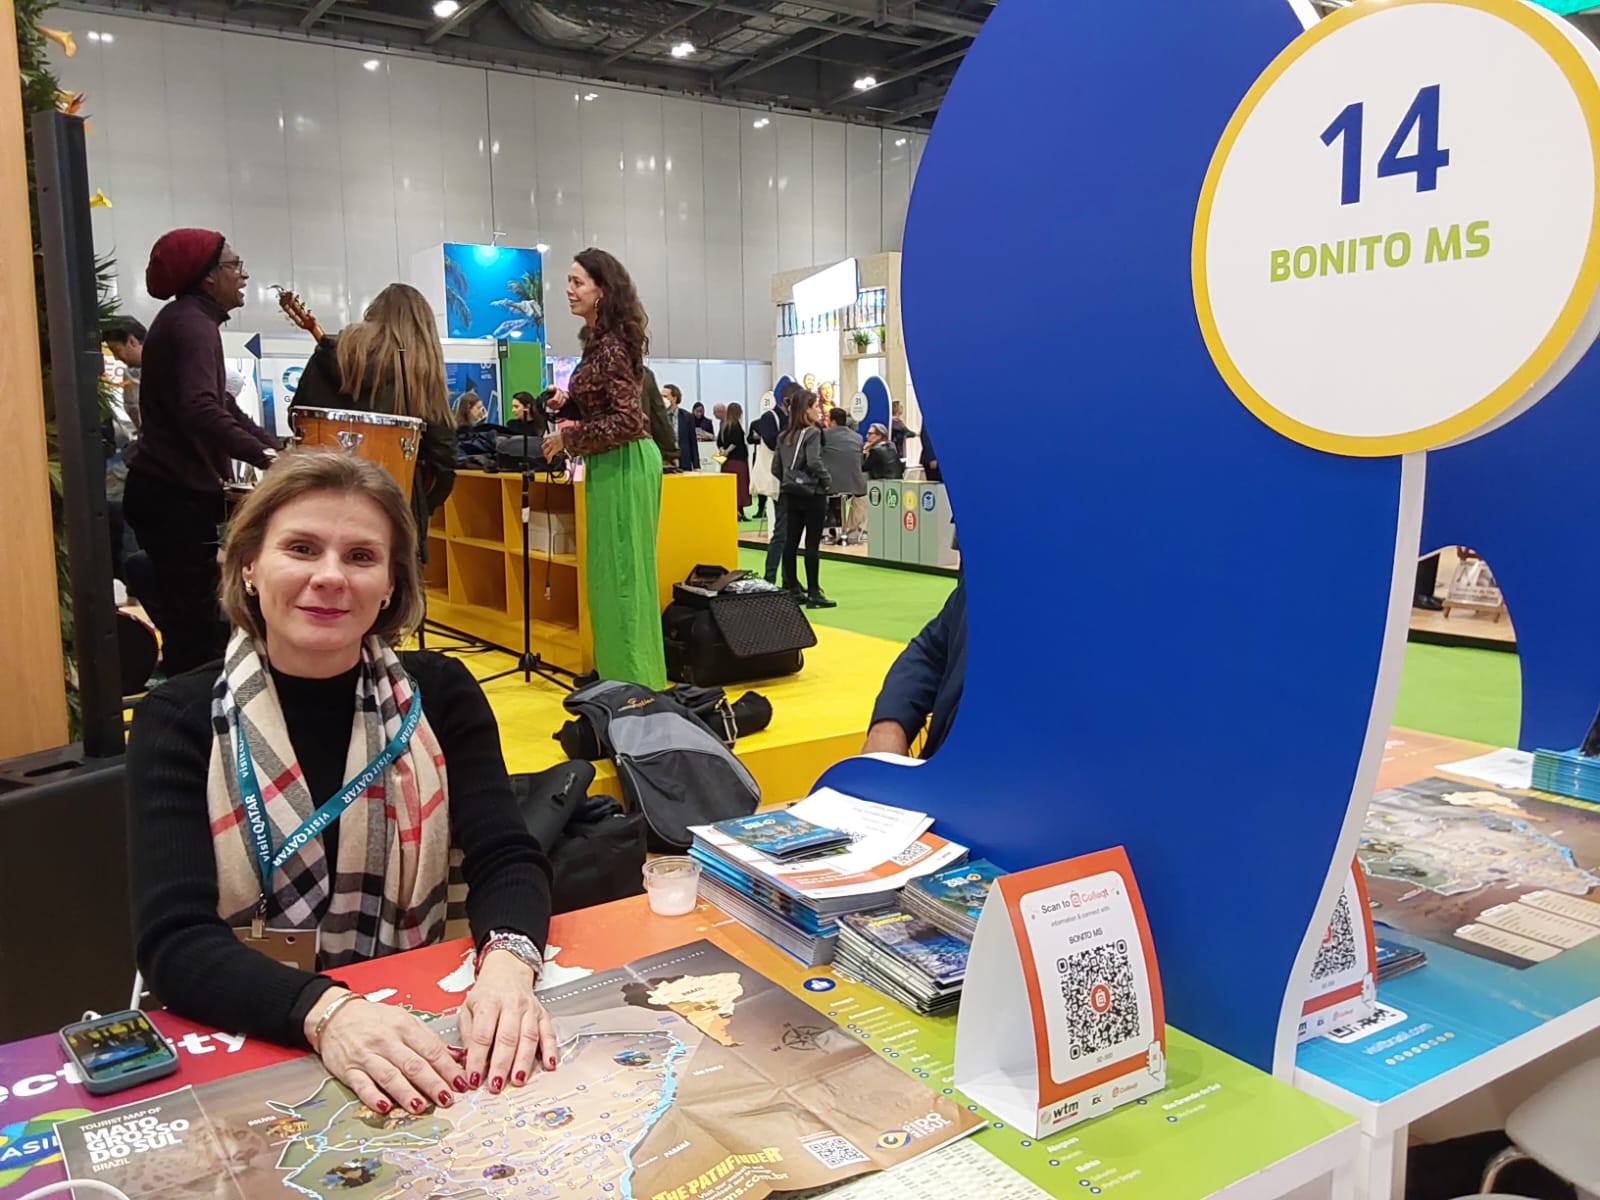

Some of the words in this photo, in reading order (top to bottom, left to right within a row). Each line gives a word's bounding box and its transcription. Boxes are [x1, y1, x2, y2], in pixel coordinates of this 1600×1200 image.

[1321, 84, 1450, 206] 14
[1269, 231, 1412, 284] BONITO
[1424, 220, 1491, 264] MS
[1041, 902, 1062, 914] Scan
[1062, 899, 1071, 909] to
[80, 1117, 122, 1131] TOURIST
[123, 1111, 147, 1122] MAP
[147, 1107, 162, 1116] OF
[1053, 1101, 1079, 1119] wtm
[83, 1116, 158, 1143] MATO
[86, 1119, 190, 1153] GROSSO
[89, 1144, 131, 1164] DO
[134, 1133, 183, 1153] SUL
[92, 1158, 131, 1173] BRAZIL
